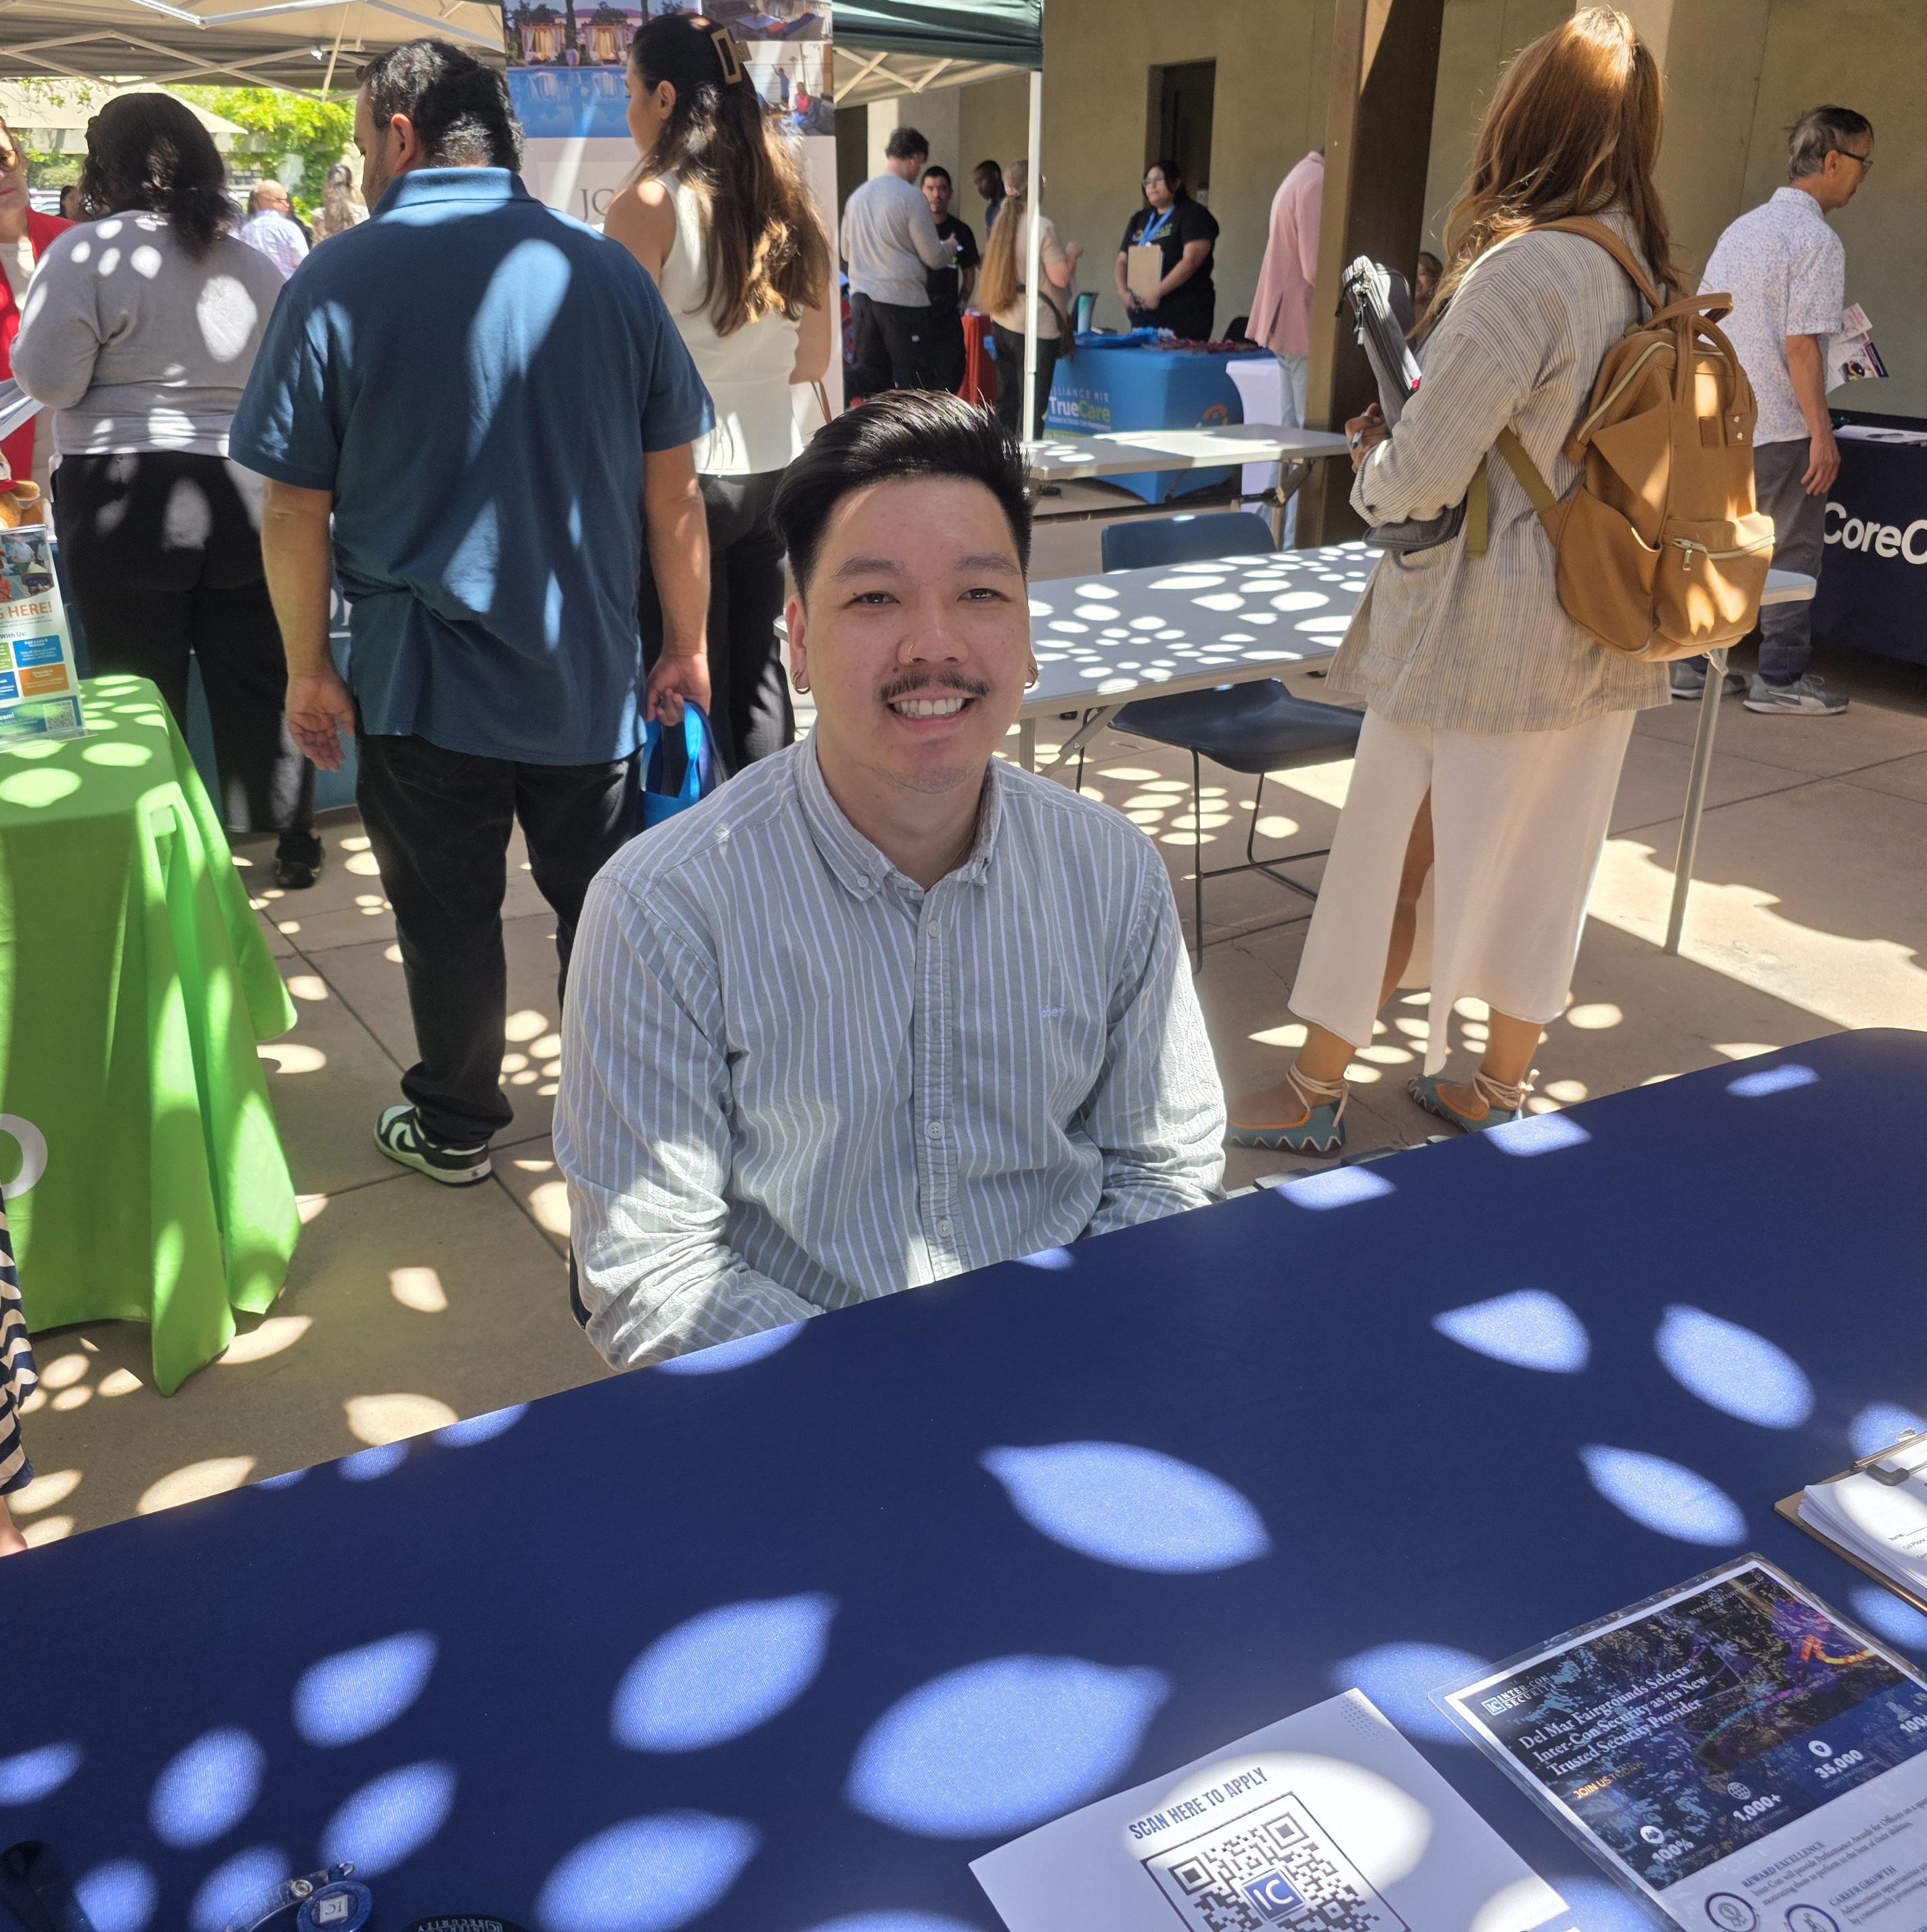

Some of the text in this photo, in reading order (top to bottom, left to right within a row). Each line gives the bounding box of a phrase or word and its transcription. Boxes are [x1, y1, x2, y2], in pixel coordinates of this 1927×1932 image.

[1048, 396, 1110, 423] TrueCare
[8, 601, 53, 619] HERE!
[1504, 1681, 1556, 1709] SECURITY
[1518, 1667, 1690, 1749] Del Mar Fairgrounds Selects
[1532, 1676, 1708, 1762] Inter-Con Security as its New
[1546, 1699, 1703, 1776] Trusted Security Provider
[1814, 1749, 1863, 1778] 35,000
[1128, 1767, 1268, 1839] SCAN HERE TO APPLY
[1573, 1783, 1599, 1799] JOIN
[1595, 1775, 1612, 1787] US
[1733, 1793, 1781, 1821] 1,000+
[1652, 1838, 1694, 1862] 100%
[1741, 1840, 1825, 1887] REWARD EXCELLENCE
[1750, 1878, 1784, 1897] Inter-Con
[1782, 1869, 1796, 1881] will
[1794, 1859, 1817, 1877] provide
[1814, 1840, 1853, 1863] Performance
[1850, 1828, 1874, 1844] Awards
[1870, 1823, 1882, 1831] for
[1879, 1812, 1904, 1826] Officers
[1762, 1885, 1798, 1906] motivating
[1793, 1877, 1811, 1889] them
[1815, 1860, 1841, 1879] perform
[1839, 1856, 1849, 1864] to
[1845, 1851, 1858, 1860] the
[1853, 1845, 1869, 1854] best
[1867, 1838, 1877, 1847] of
[1874, 1833, 1890, 1844] their
[1829, 1865, 1897, 1906] CAREER GROWTH
[1253, 1879, 1294, 1910] IC
[1840, 1889, 1882, 1916] Advancement
[1880, 1868, 1921, 1893] opportunities
[1848, 1916, 1861, 1925] by
[1859, 1897, 1895, 1920] consistently
